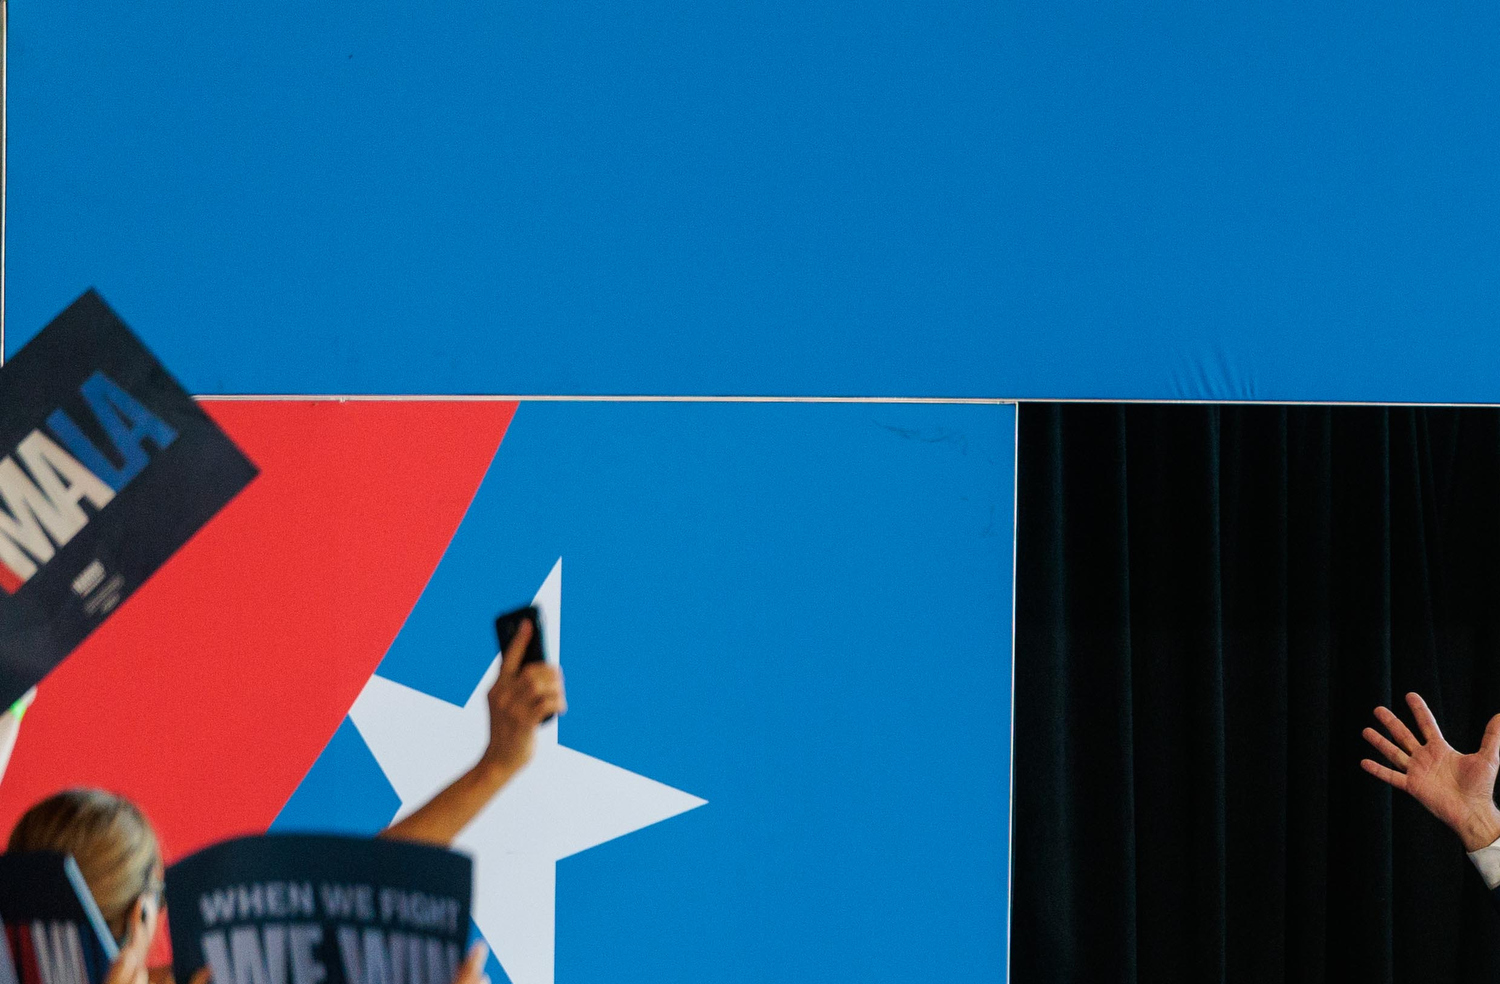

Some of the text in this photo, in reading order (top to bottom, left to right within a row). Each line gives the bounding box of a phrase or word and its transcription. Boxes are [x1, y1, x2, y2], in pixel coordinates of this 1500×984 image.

[0, 370, 180, 595] MALA
[200, 881, 463, 934] WHEN WE FIGHT
